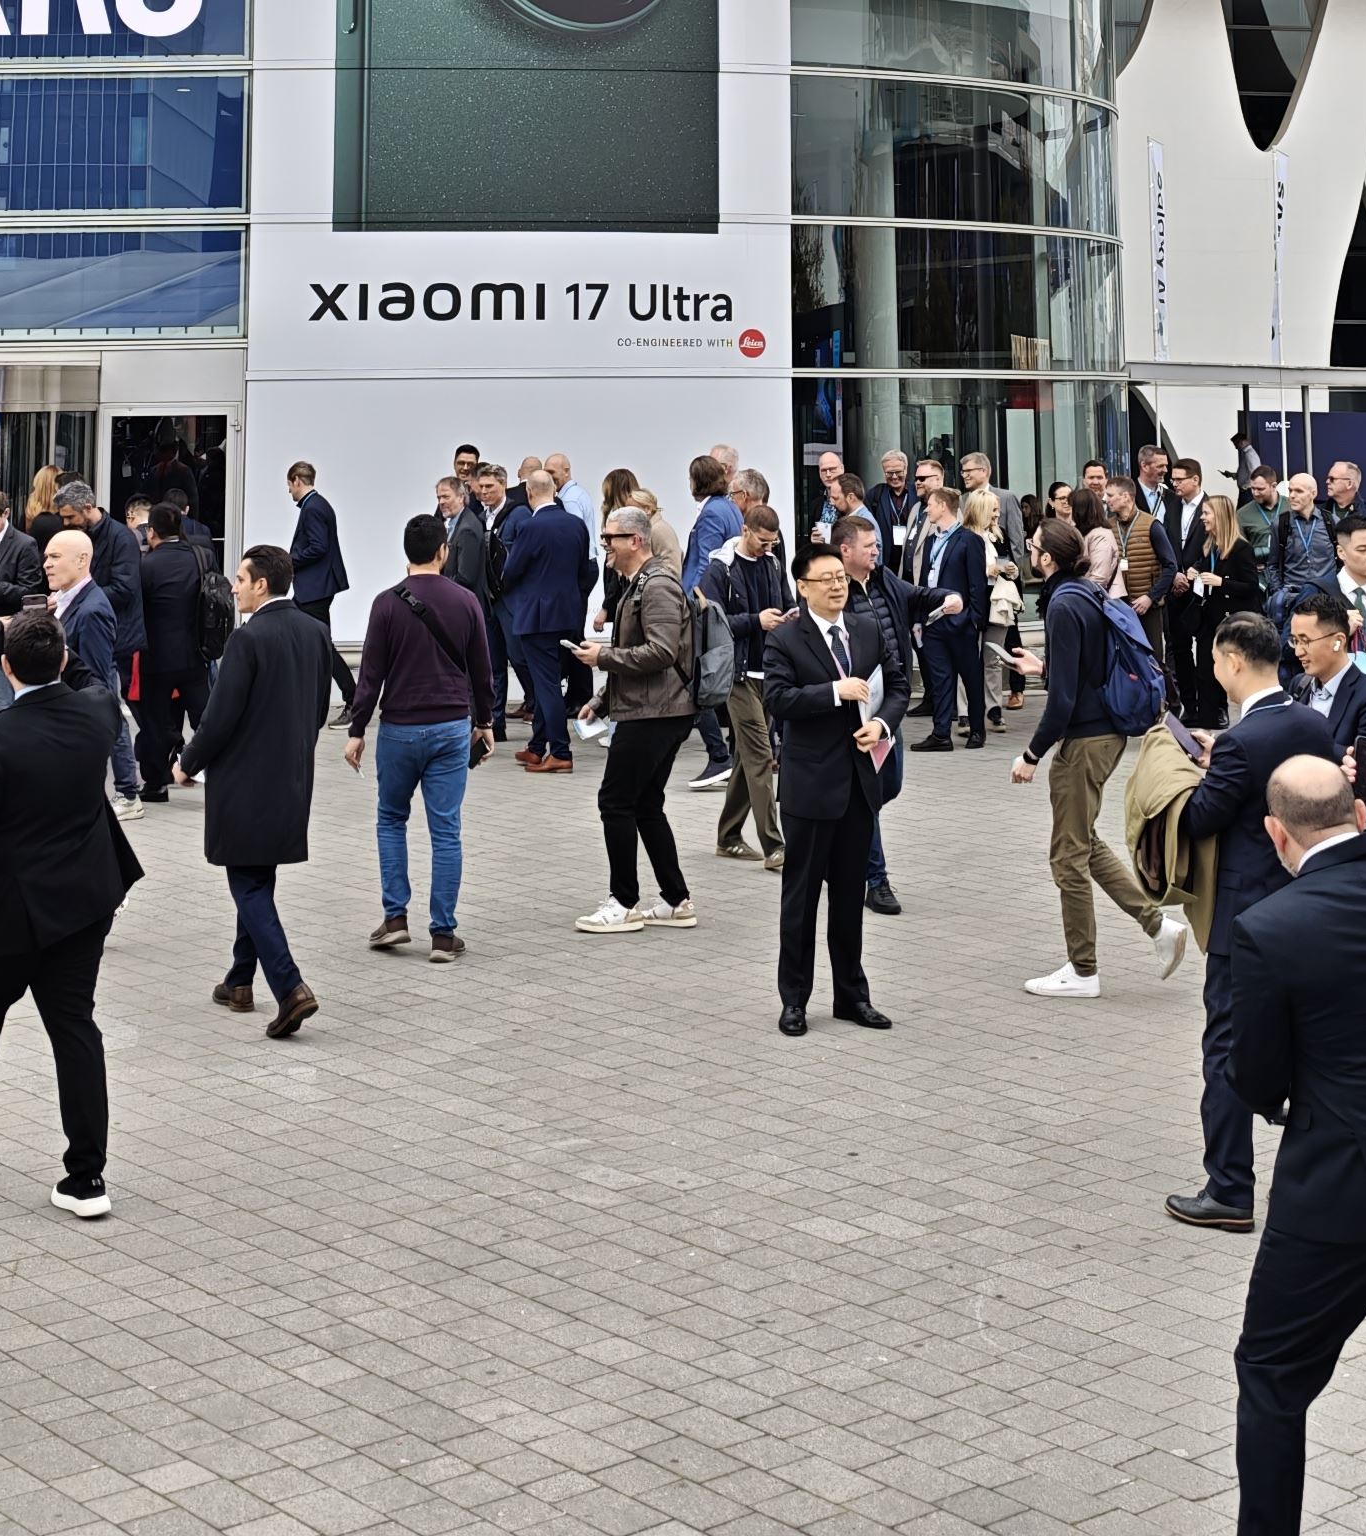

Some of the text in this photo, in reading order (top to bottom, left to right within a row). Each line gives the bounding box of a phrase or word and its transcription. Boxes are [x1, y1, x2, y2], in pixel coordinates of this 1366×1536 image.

[565, 283, 609, 320] 17
[628, 283, 733, 322] Ultra
[617, 336, 764, 349] CO-ENGINEERED WITH Leica
